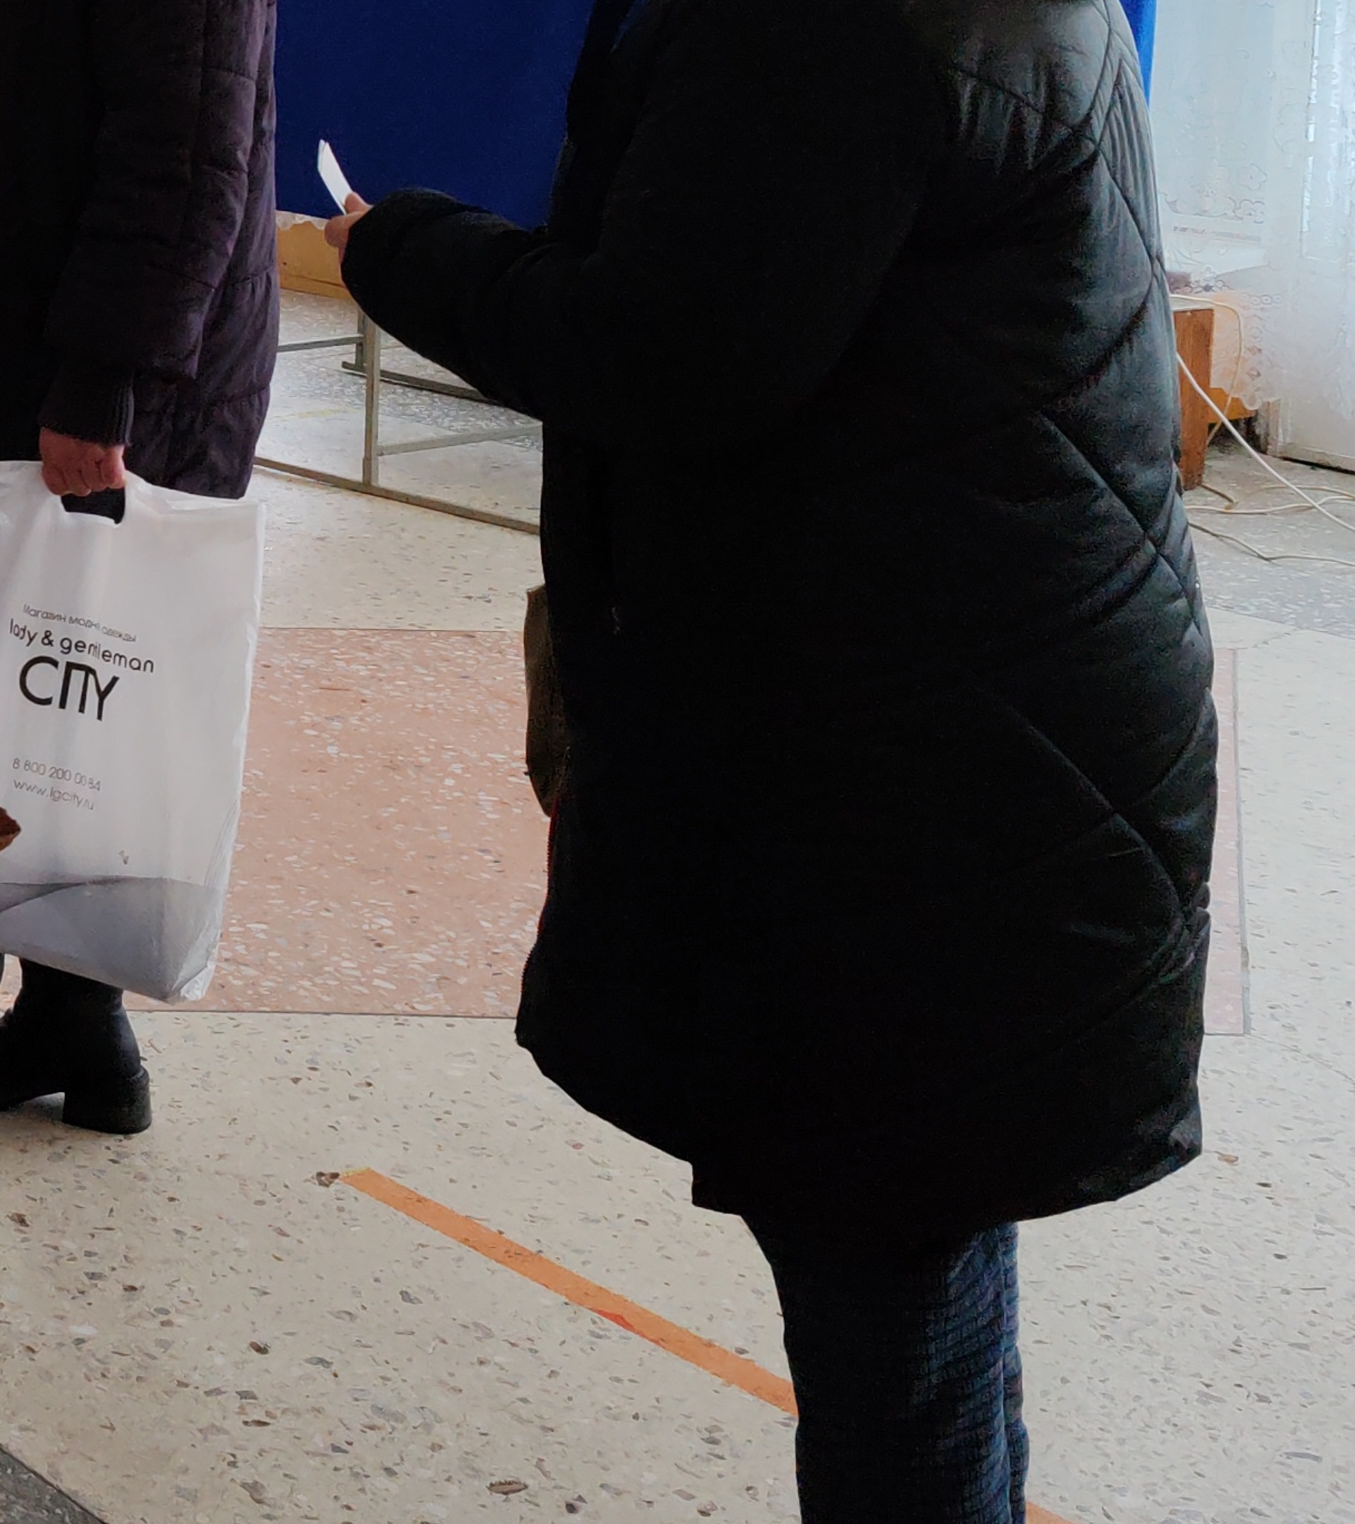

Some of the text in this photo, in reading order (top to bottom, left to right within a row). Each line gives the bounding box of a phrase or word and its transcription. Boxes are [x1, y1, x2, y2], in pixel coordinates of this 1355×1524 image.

[41, 629, 54, 647] &
[19, 654, 121, 722] CITY
[12, 757, 21, 770] 8
[23, 759, 47, 776] 800
[49, 766, 72, 782] 200
